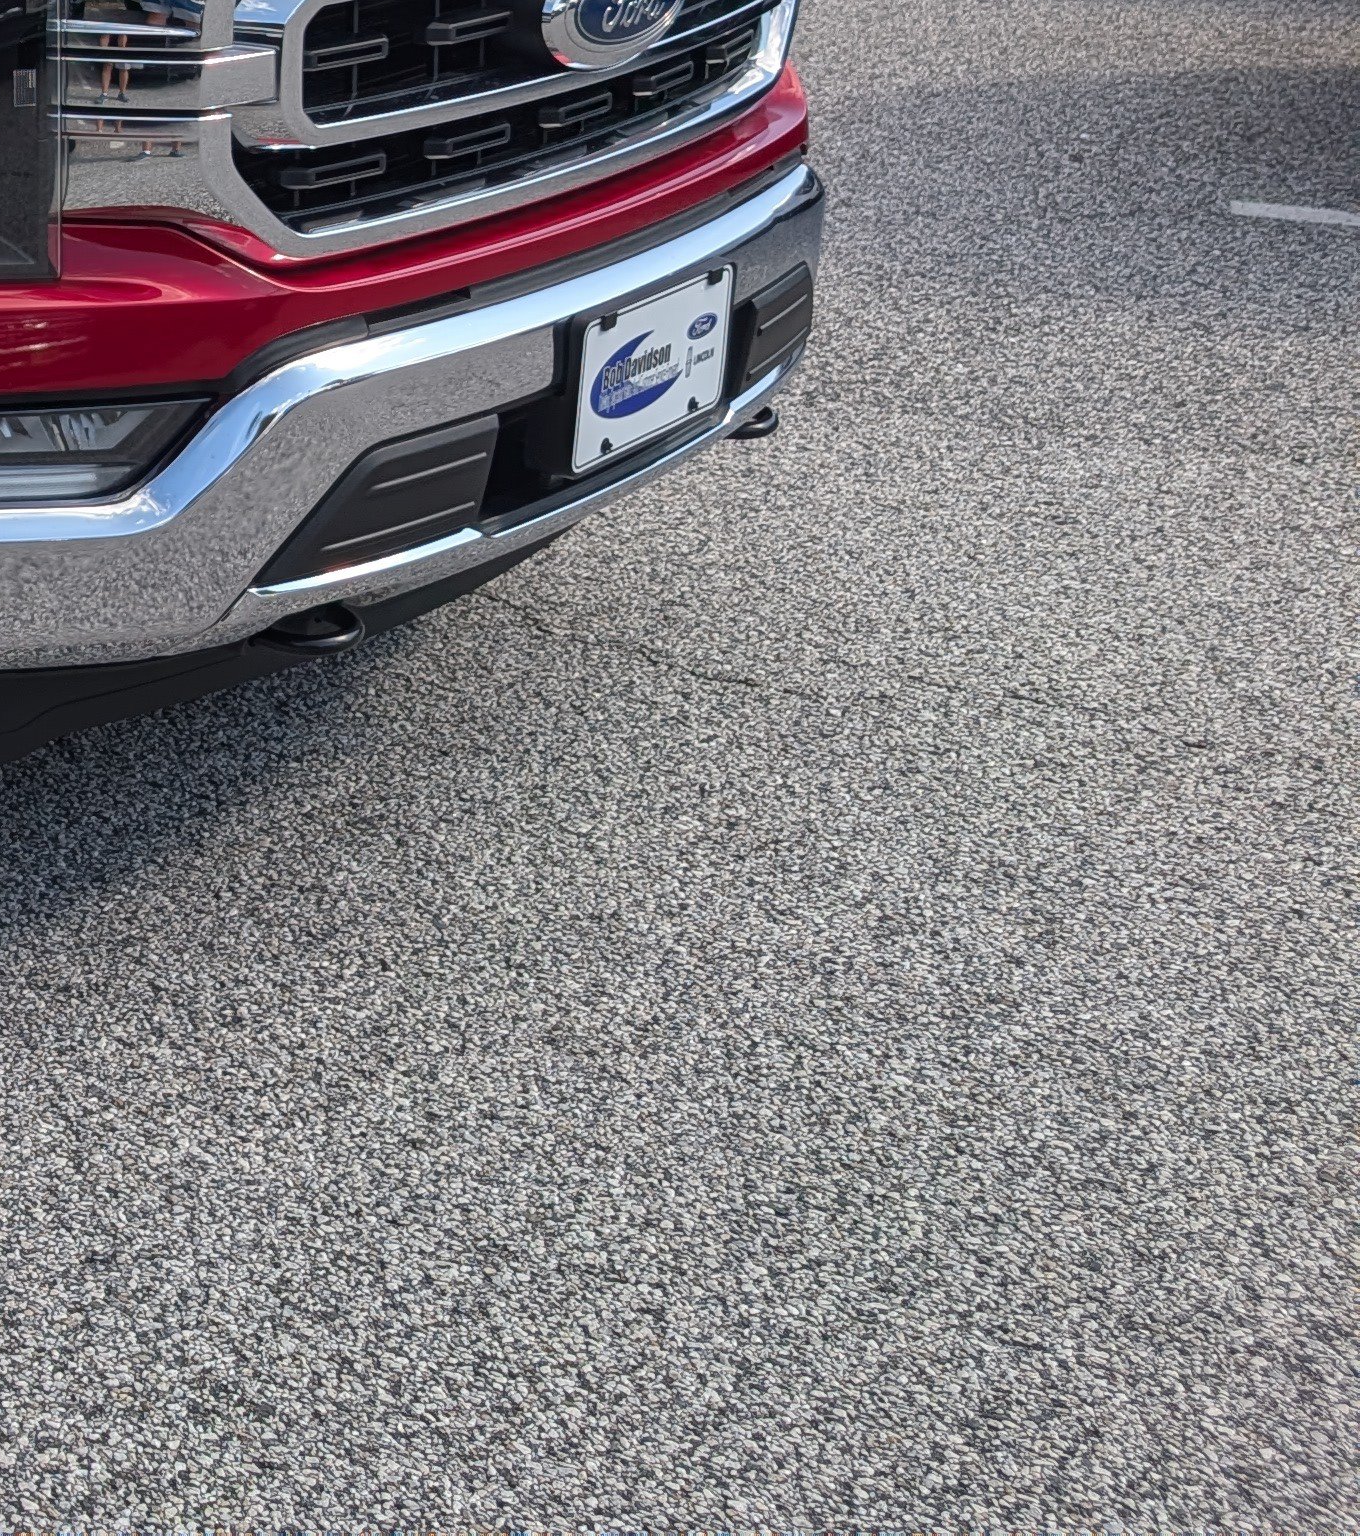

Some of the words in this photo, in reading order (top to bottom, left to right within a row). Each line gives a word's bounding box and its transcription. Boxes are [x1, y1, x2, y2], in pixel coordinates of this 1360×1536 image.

[692, 317, 713, 337] Ford
[693, 347, 714, 366] LINCOLN
[602, 359, 624, 391] Bob
[624, 343, 672, 380] Davidson
